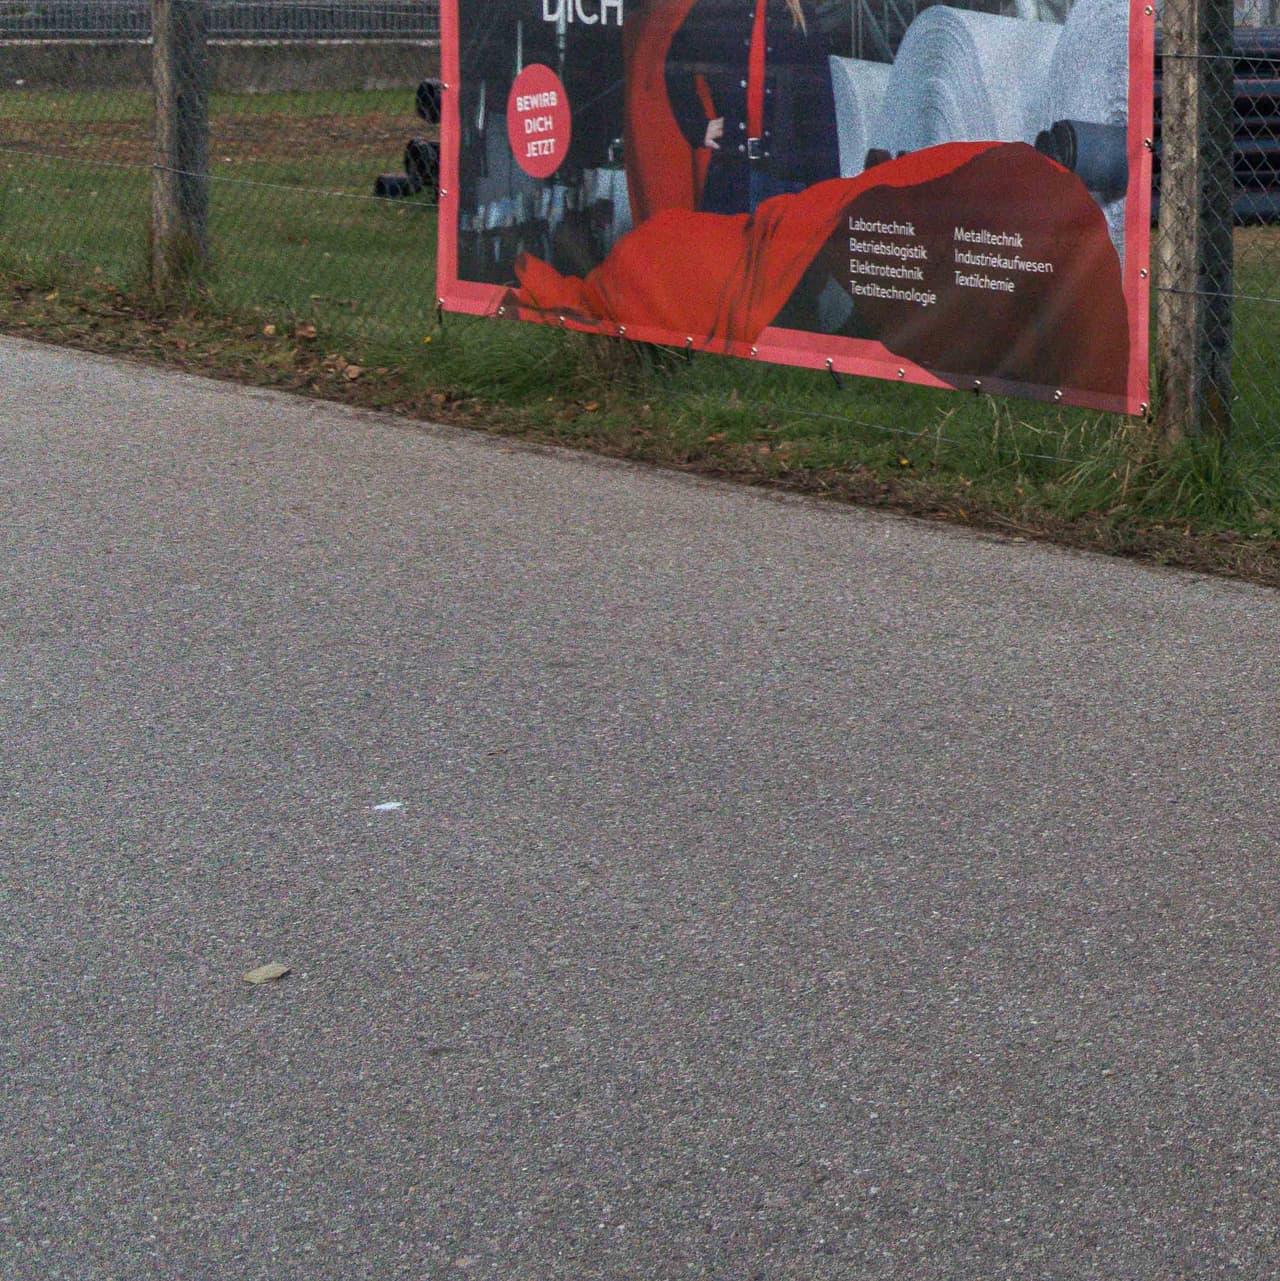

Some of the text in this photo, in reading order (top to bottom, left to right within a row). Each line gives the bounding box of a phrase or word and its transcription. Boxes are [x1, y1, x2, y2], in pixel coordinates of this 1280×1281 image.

[516, 91, 558, 112] BEWIRB
[524, 116, 553, 134] DICH
[526, 138, 556, 158] JETZT
[849, 216, 916, 236] Labortechnik
[849, 237, 928, 261] Betriebslogistik
[954, 227, 1024, 249] Metalltechnik
[850, 259, 924, 281] Elektrotechnik
[954, 248, 1054, 273] Industriekaufwesen
[850, 280, 937, 306] Textiltechnologie
[954, 271, 1016, 293] Textilchemie
